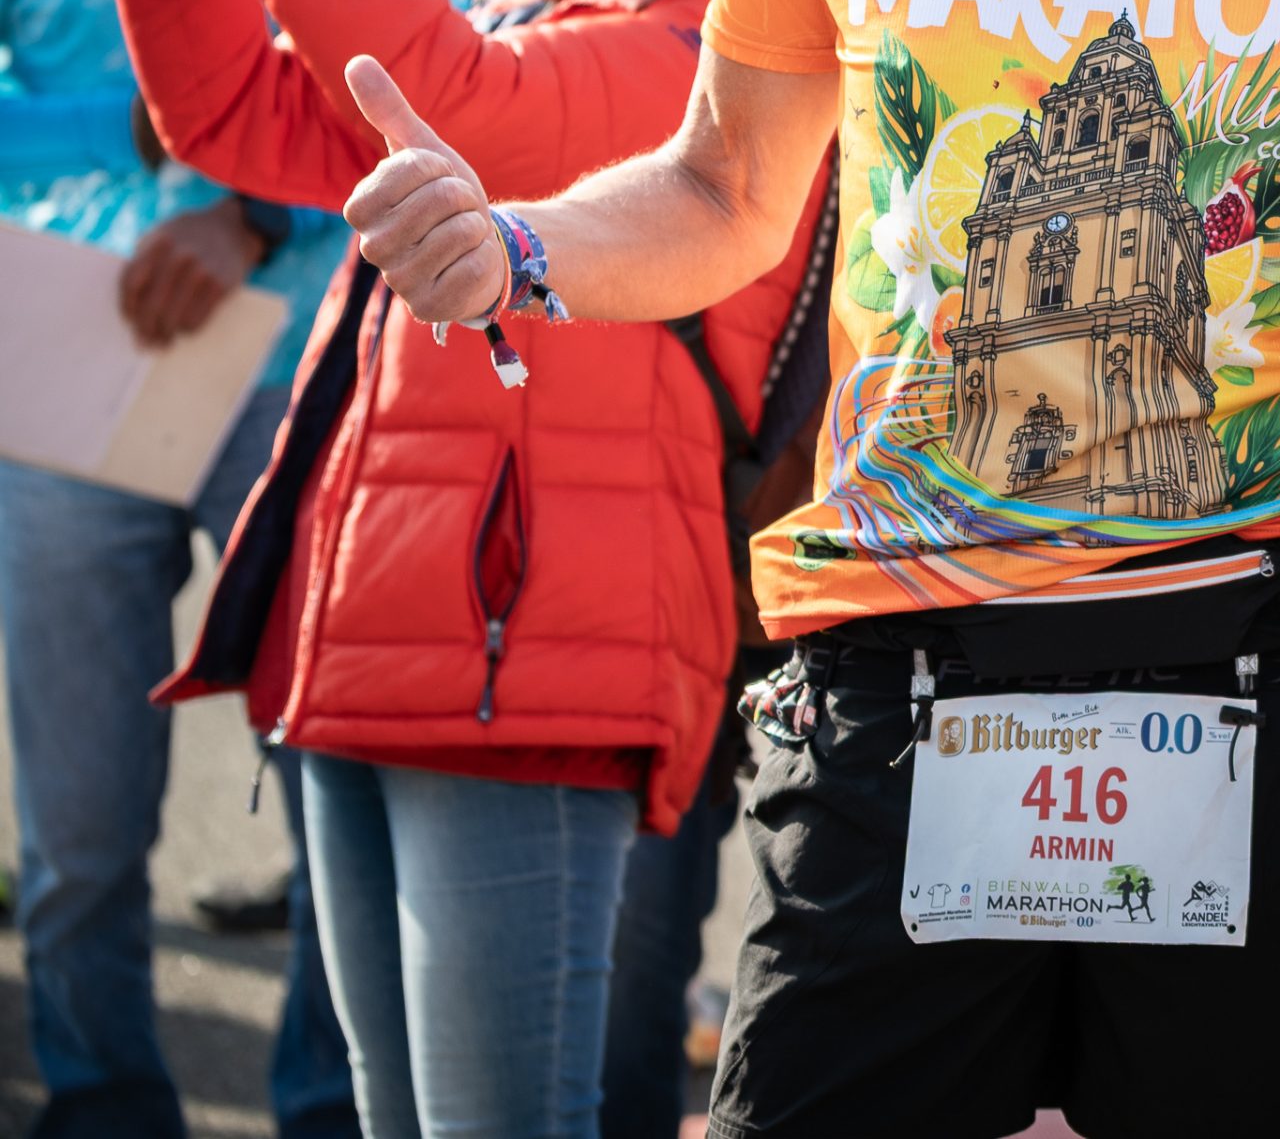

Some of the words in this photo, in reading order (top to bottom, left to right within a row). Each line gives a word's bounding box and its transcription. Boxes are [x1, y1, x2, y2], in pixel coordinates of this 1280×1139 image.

[968, 713, 1102, 755] Bitburger
[1141, 712, 1203, 754] 0.0
[1021, 765, 1128, 825] 416
[1030, 835, 1114, 862] ARMIN
[988, 880, 1090, 894] BIENWALD
[987, 895, 1103, 913] MARATHON
[1204, 903, 1222, 911] TSV
[1029, 915, 1067, 927] Bitburger
[1182, 912, 1228, 922] KANDEL
